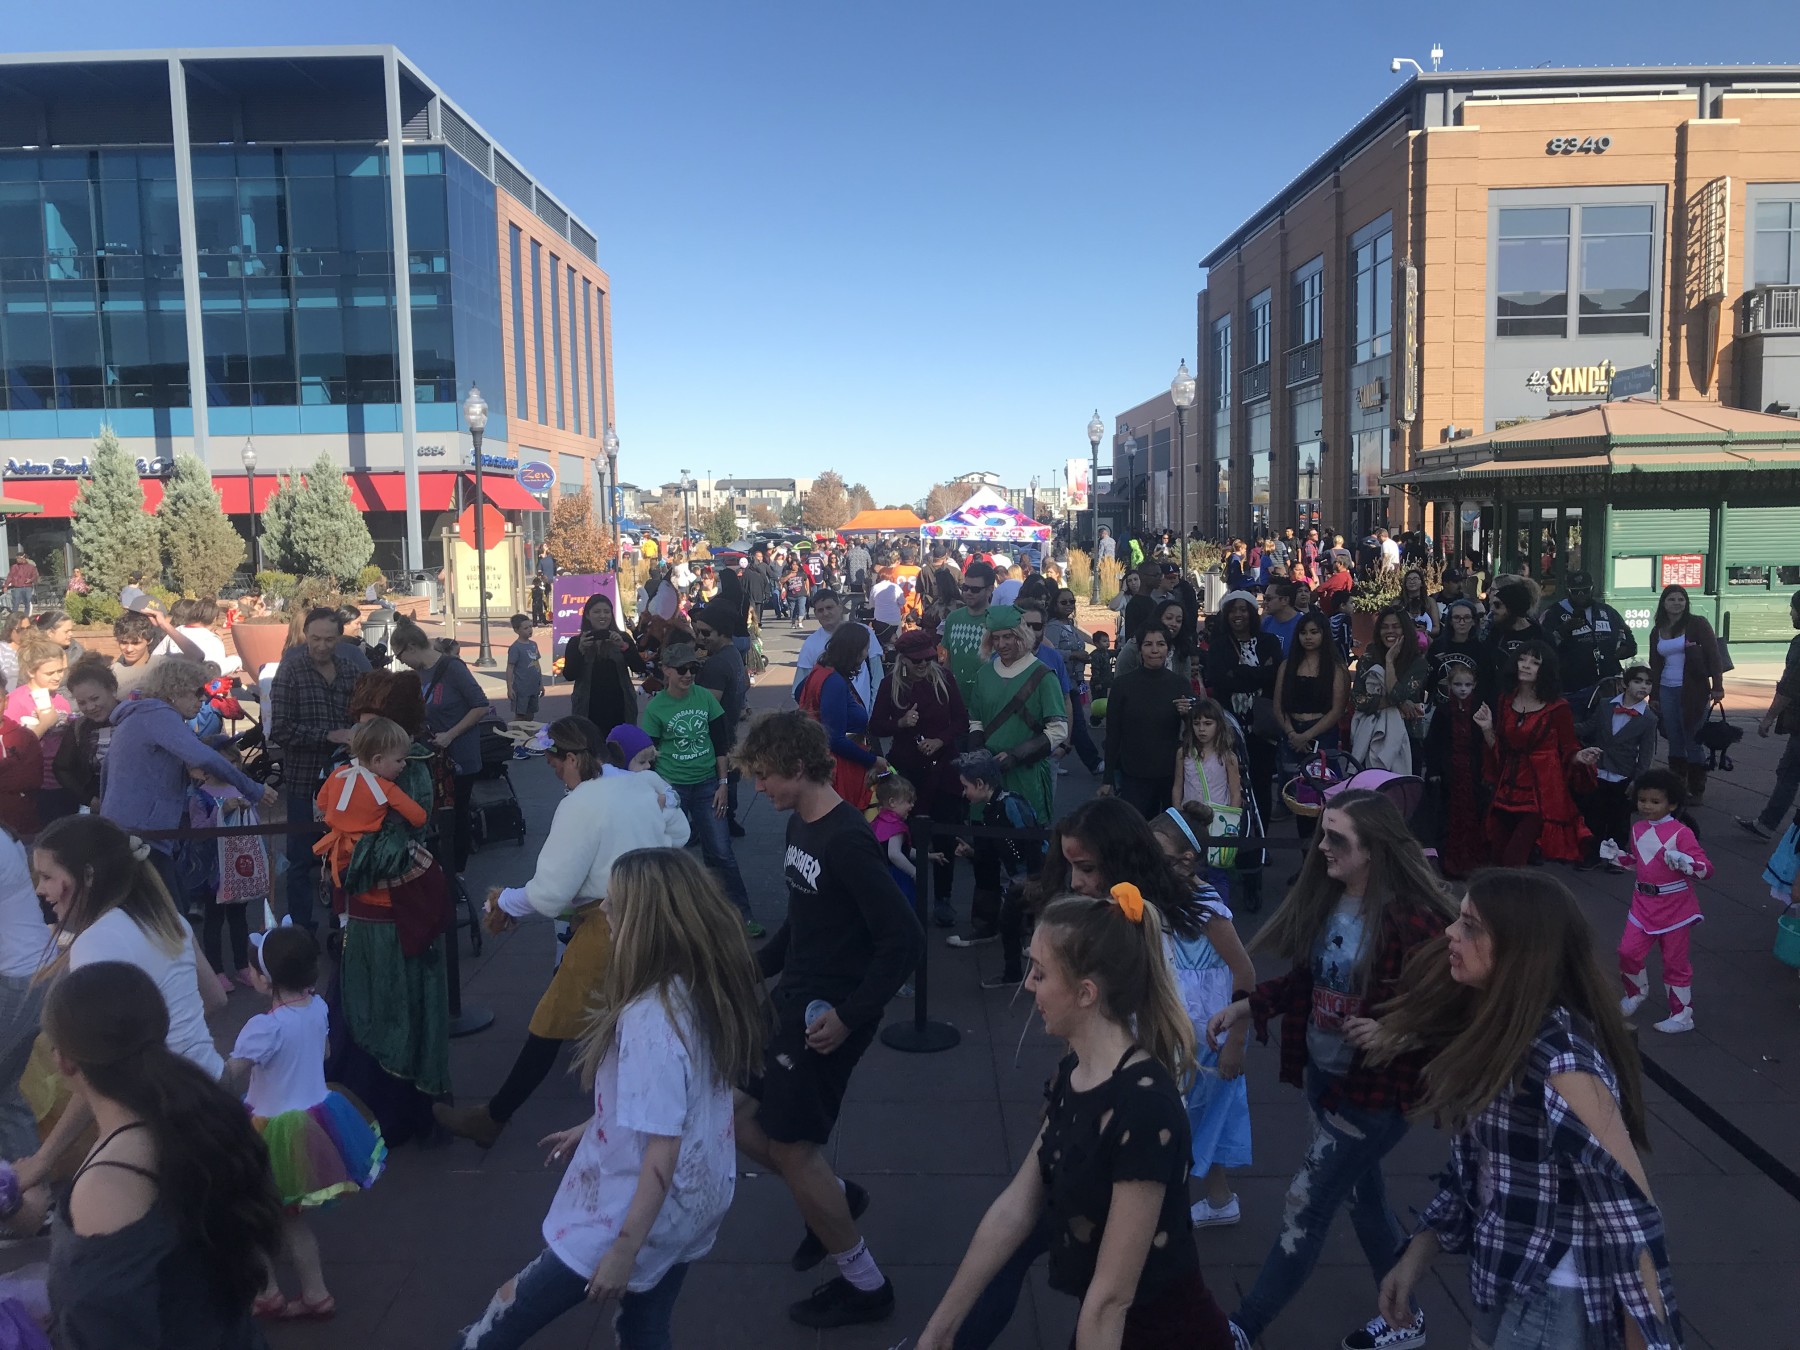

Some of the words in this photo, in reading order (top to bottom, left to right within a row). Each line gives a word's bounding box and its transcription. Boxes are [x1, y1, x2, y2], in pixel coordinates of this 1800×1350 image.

[1549, 135, 1613, 152] 8340
[1529, 370, 1549, 385] La
[1550, 359, 1616, 394] SANDÍ
[52, 456, 90, 475] Sush
[522, 468, 551, 479] Zen
[808, 563, 821, 576] 95
[1625, 609, 1651, 619] 8340
[672, 709, 694, 722] URBAN
